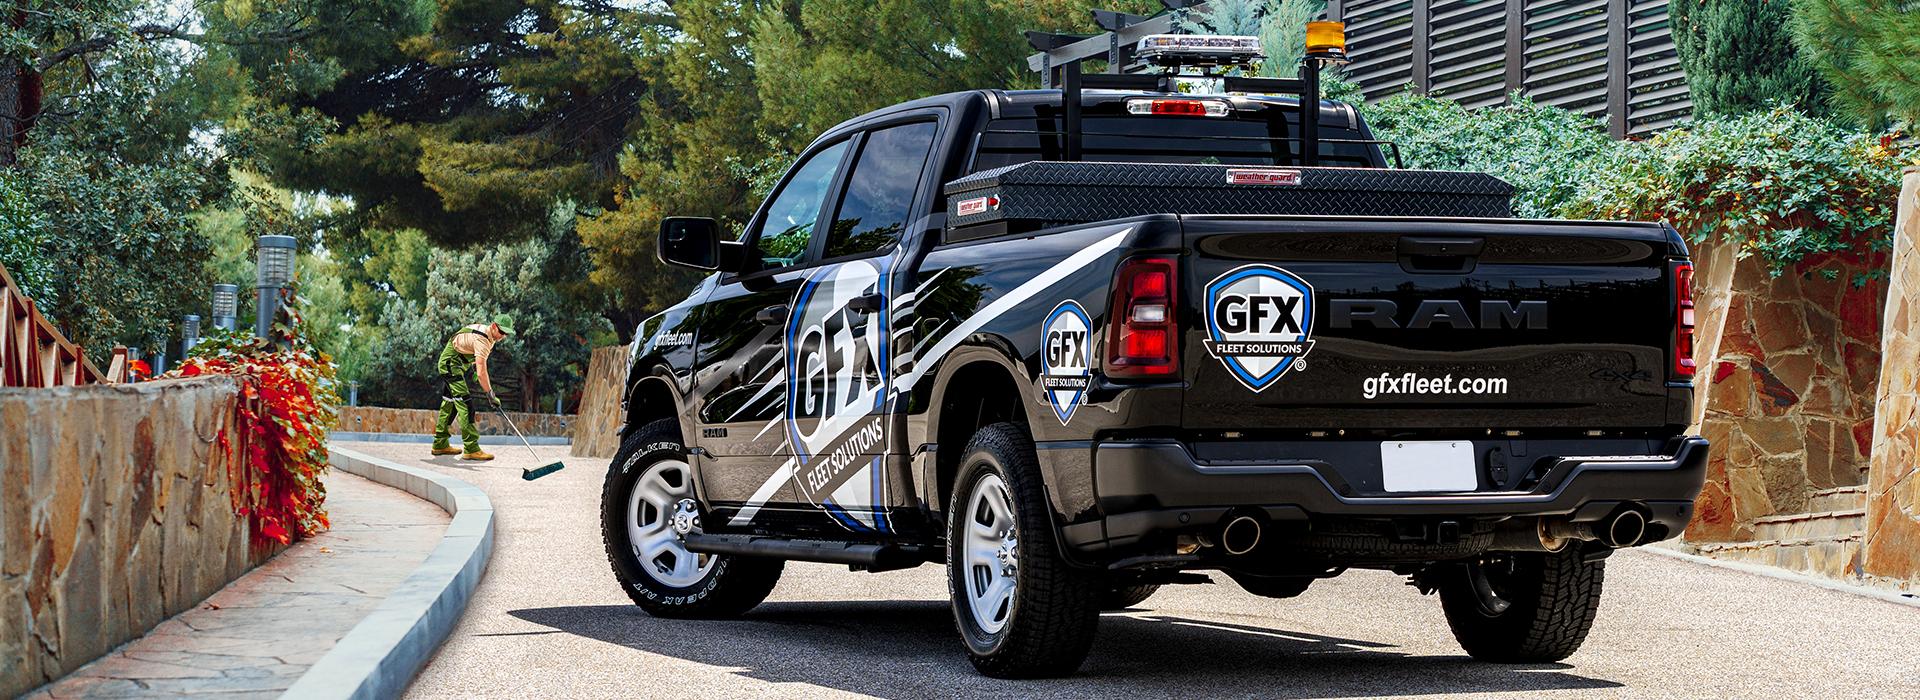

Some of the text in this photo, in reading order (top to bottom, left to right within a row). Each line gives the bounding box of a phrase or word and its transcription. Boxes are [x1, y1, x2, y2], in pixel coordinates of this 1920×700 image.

[1269, 173, 1293, 182] guard
[1216, 295, 1302, 334] GFX
[1330, 299, 1548, 330] RAM
[797, 281, 882, 439] GFX
[1046, 331, 1086, 368] GFX
[1217, 344, 1302, 353] FLEET SOLUTIONS
[1046, 378, 1086, 388] FLEET SOLUTIONS
[1363, 373, 1508, 399] gfxfleet.com
[703, 428, 727, 438] RAM
[807, 416, 883, 495] FLEET SOLUTIONS
